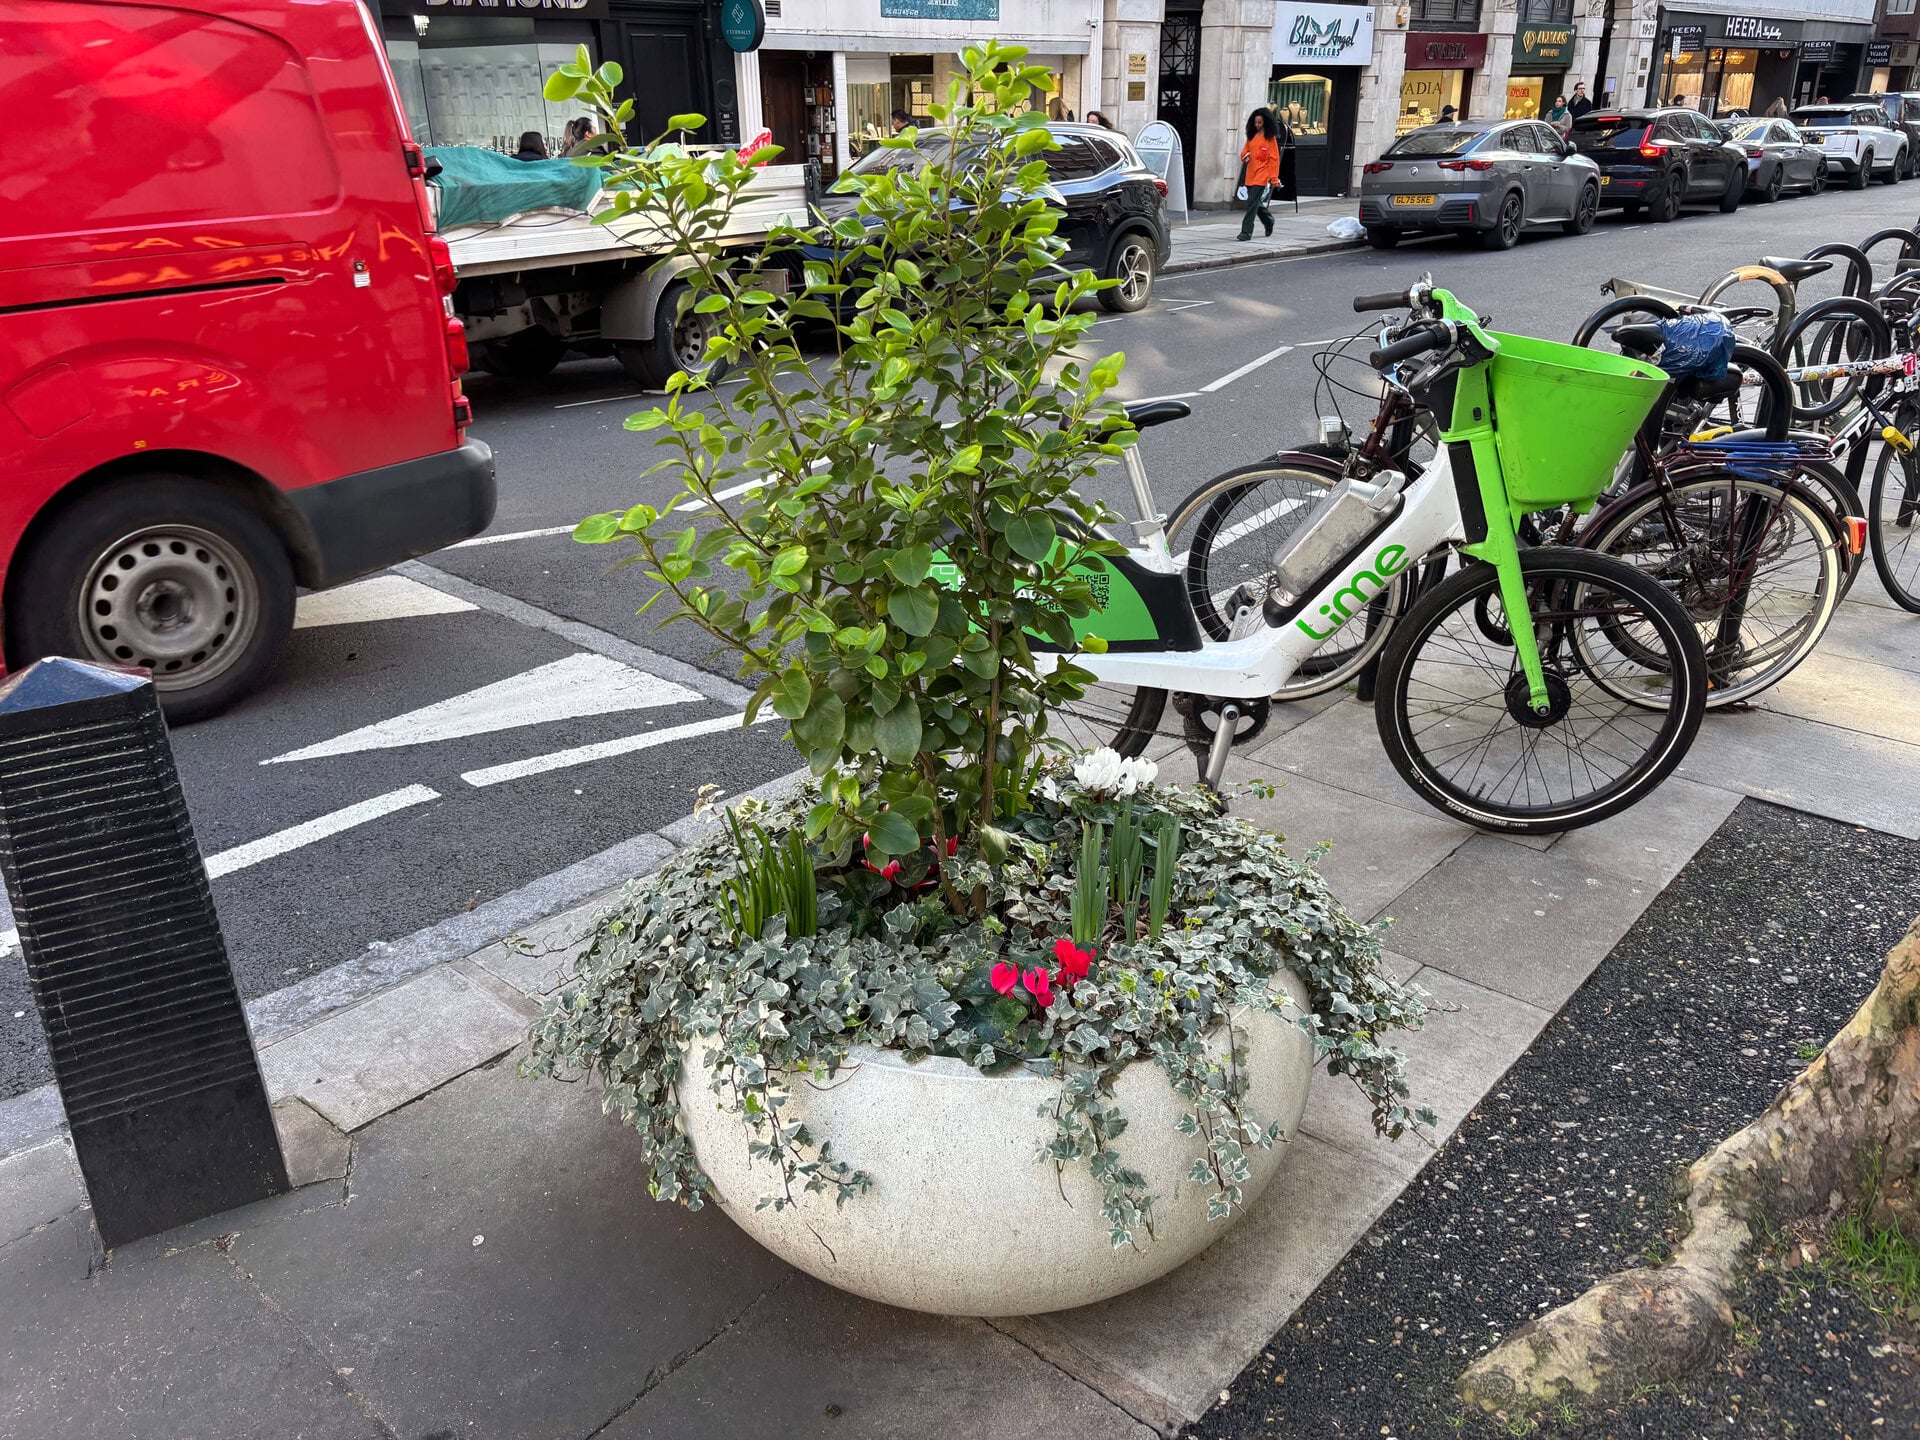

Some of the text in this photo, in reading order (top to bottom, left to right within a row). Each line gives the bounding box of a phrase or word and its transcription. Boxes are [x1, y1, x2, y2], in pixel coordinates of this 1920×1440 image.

[1671, 26, 1703, 34] HEERA
[1725, 17, 1763, 38] HEERA
[1289, 15, 1360, 51] Blue Angel
[1297, 47, 1341, 57] JEWELLERS
[1869, 43, 1891, 51] Luxury
[1396, 196, 1431, 204] GL75 SKE
[1295, 544, 1411, 640] Lime
